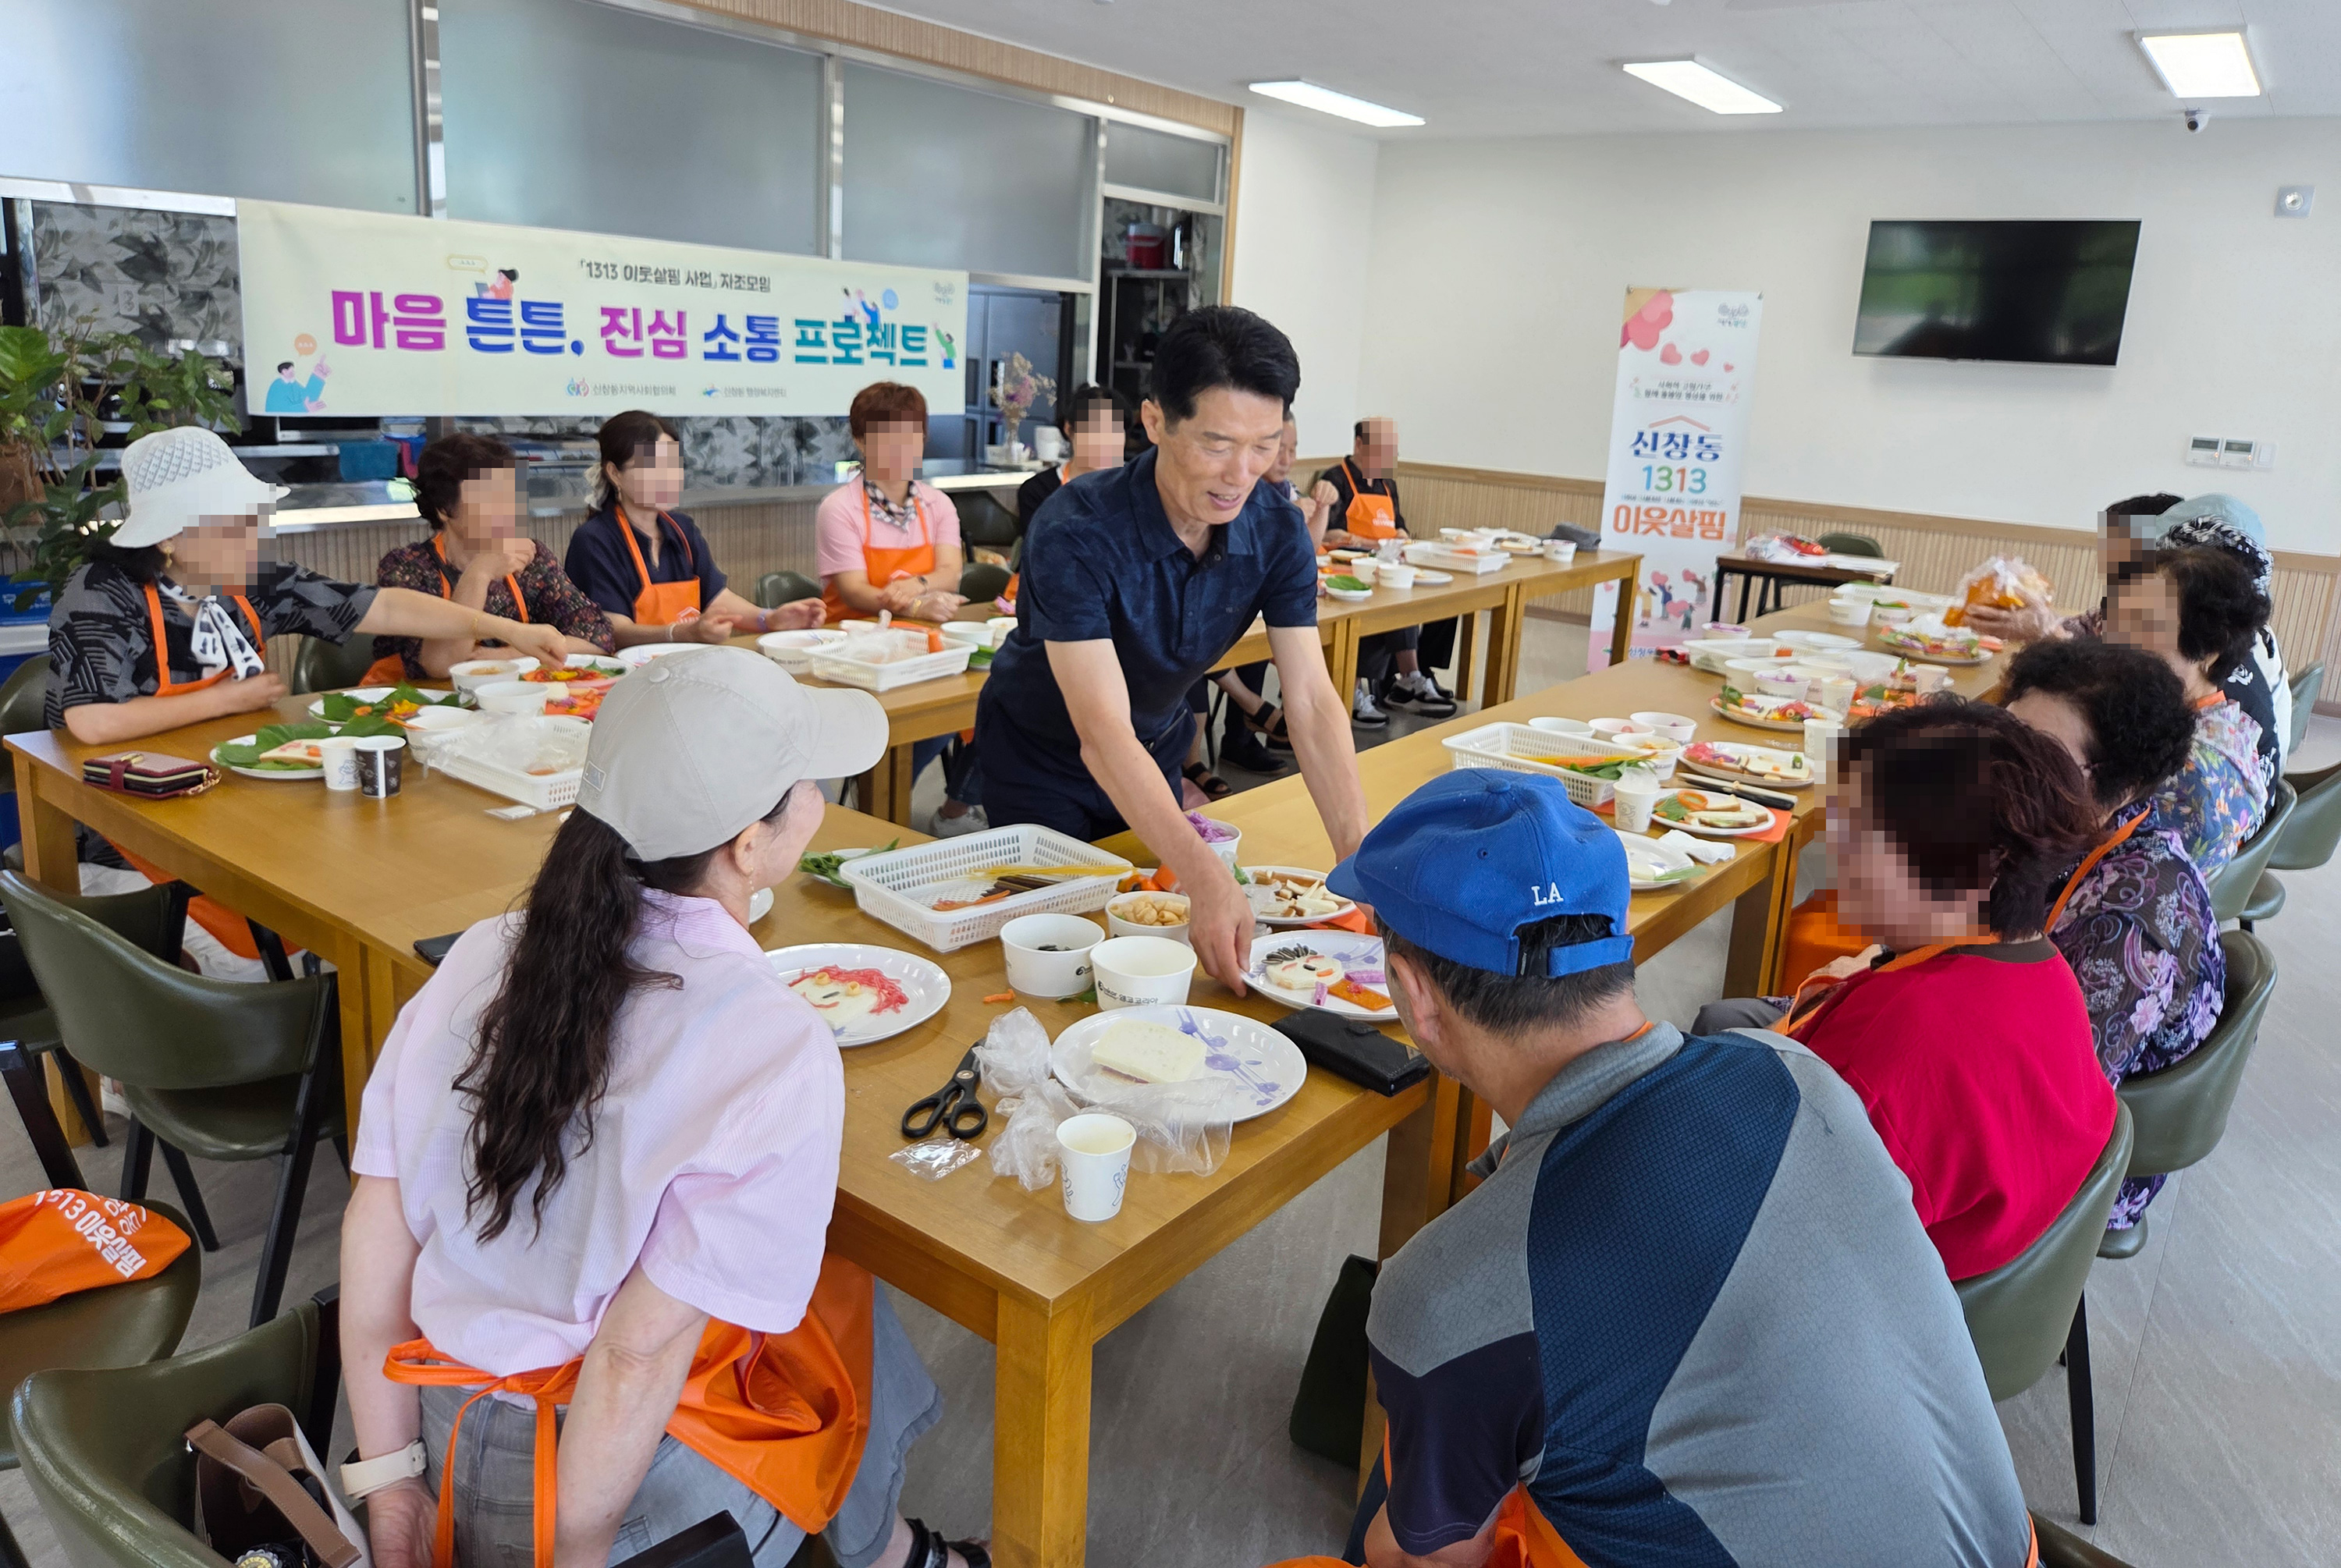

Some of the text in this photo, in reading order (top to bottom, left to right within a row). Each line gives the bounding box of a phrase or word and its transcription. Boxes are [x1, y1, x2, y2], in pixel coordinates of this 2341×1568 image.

[623, 264, 680, 286] 이웃살핌
[720, 272, 771, 293] 자조모임
[332, 290, 929, 367] 마음 튼튼, 진심 소통 프로젝트
[1642, 465, 1707, 495] 1313
[1612, 505, 1727, 541] 이웃살핌
[1531, 882, 1564, 906] LA
